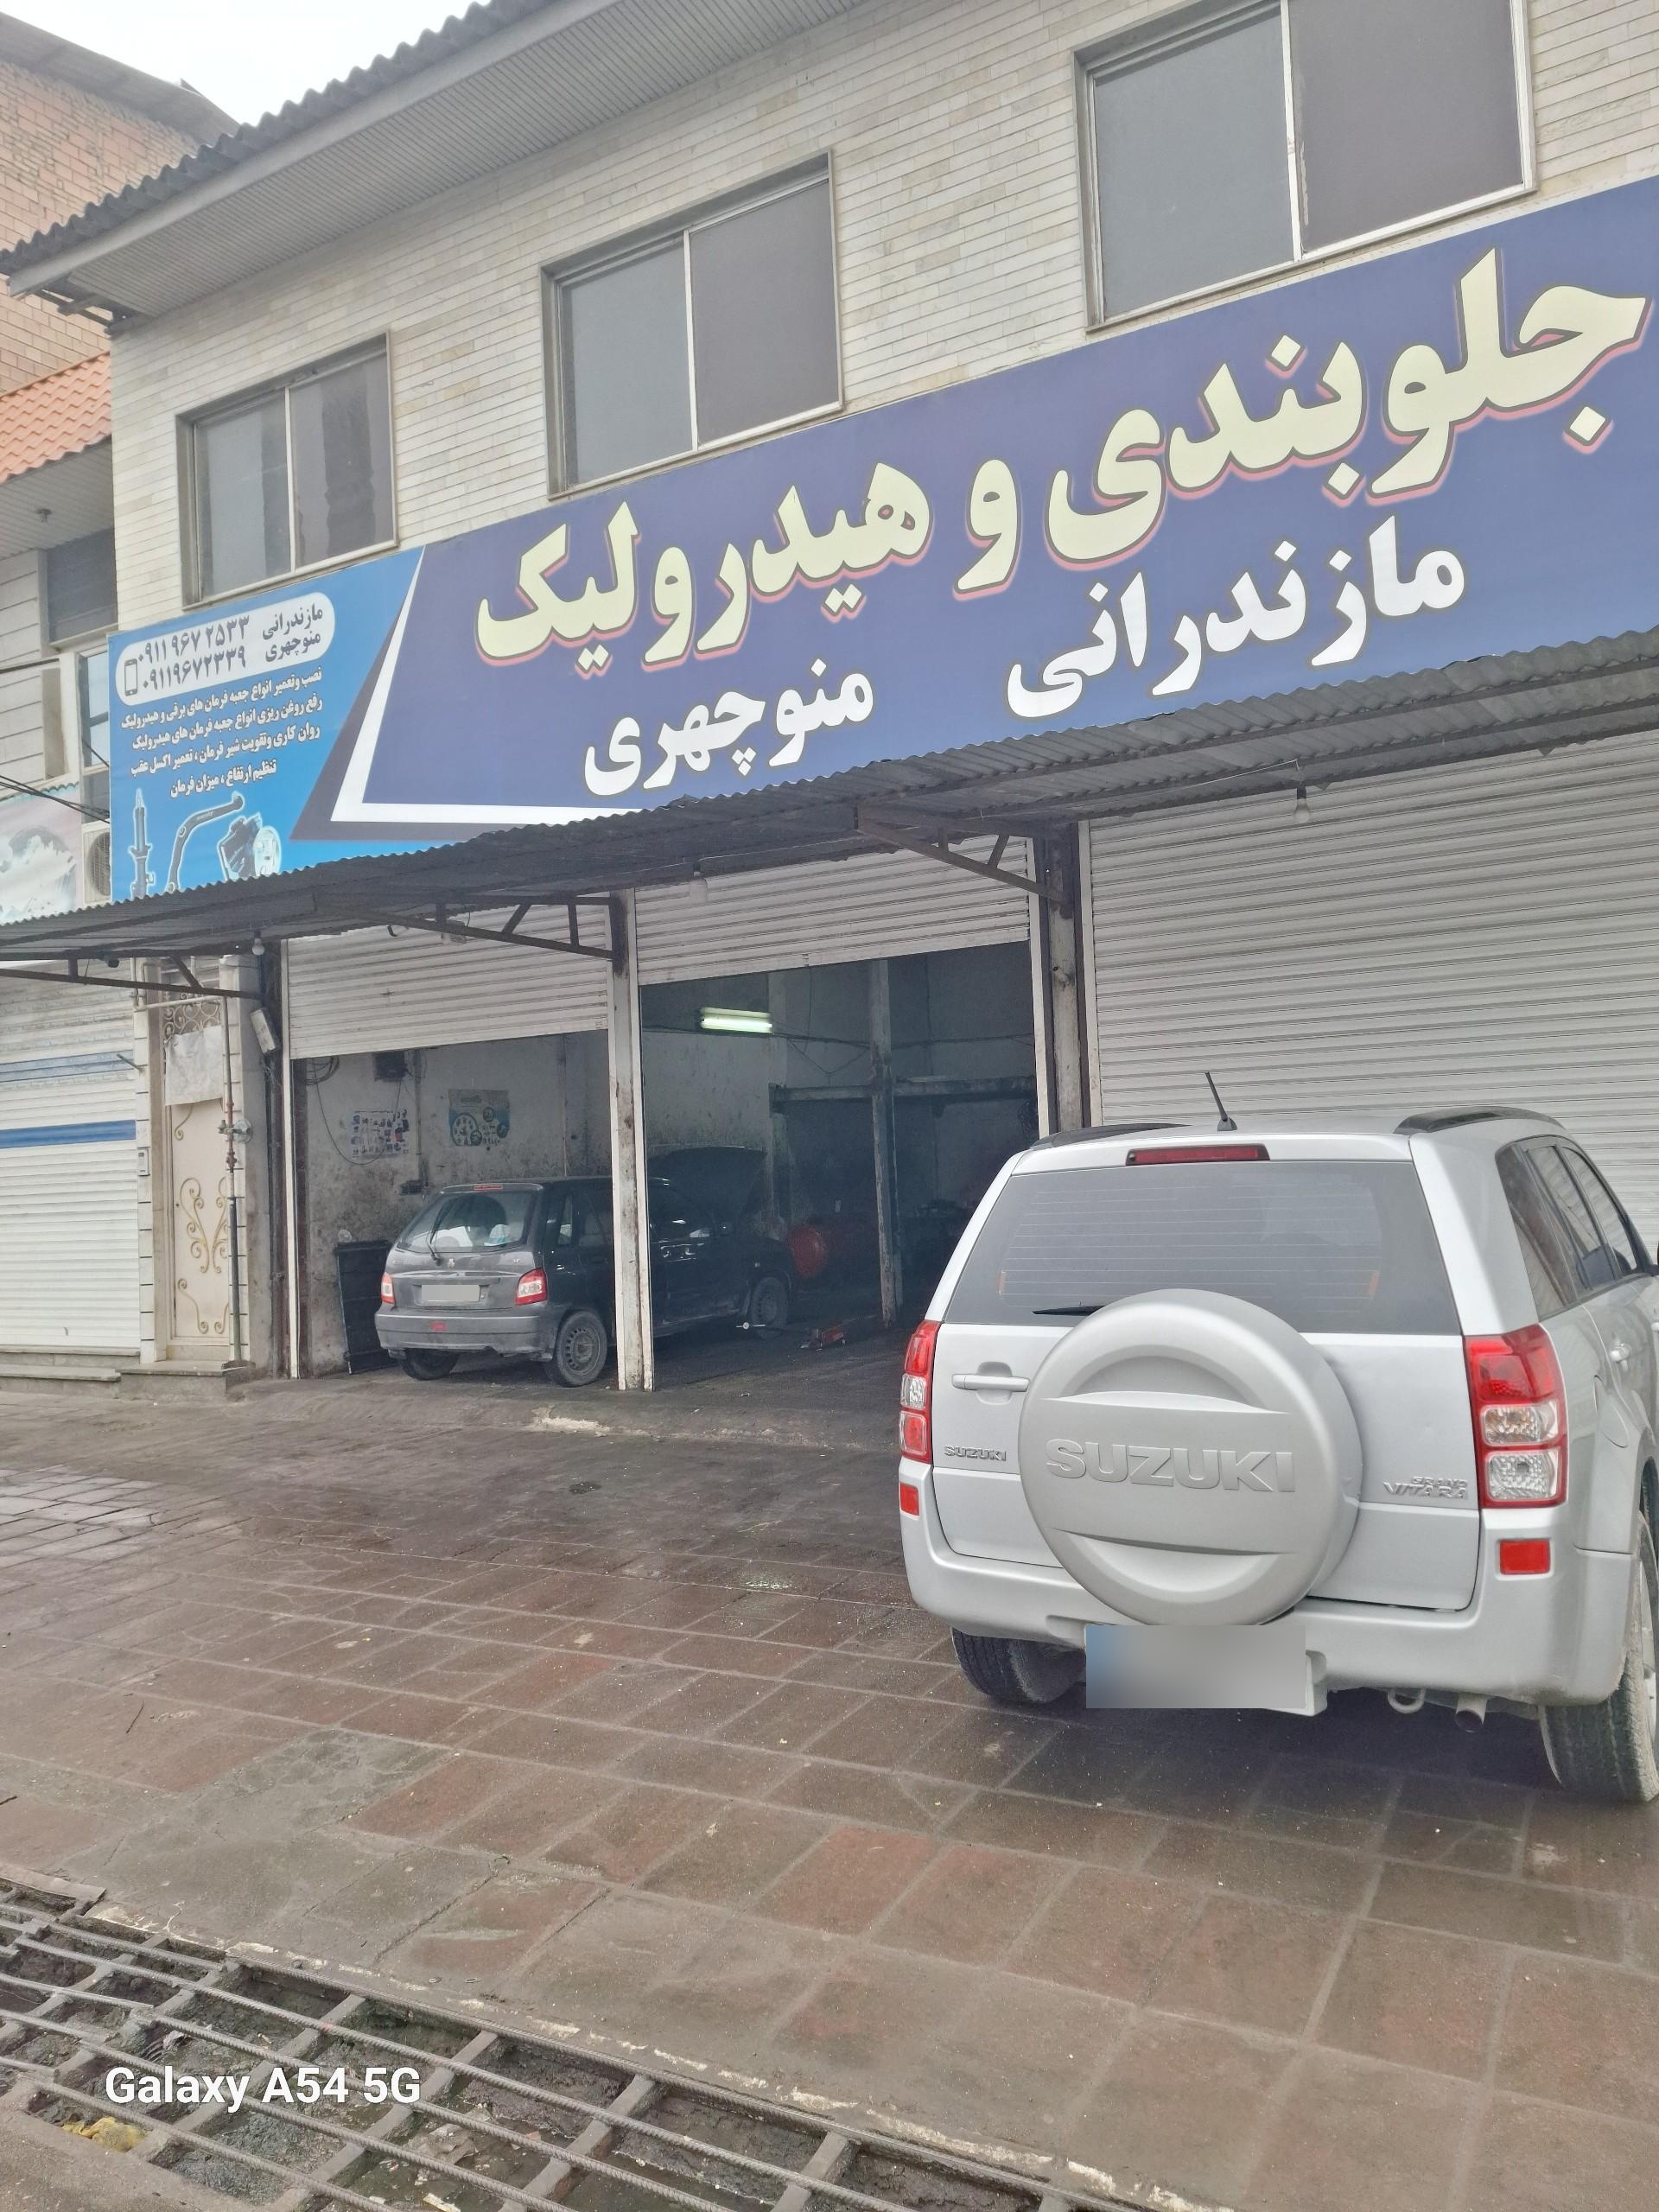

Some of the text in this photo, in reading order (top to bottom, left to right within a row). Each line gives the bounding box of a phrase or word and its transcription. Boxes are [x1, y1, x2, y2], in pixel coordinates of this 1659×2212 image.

[475, 247, 1648, 672] جلوبندی و هیدرولیک
[137, 603, 323, 664] مازندرانی ۰۹۱۱ ۹۶۷ ۲۵۳۳
[143, 629, 321, 690] منوچهری ۰۹۱۱۹۶۷۲۳۳۹
[584, 514, 1466, 796] مازندرانی منوچهری
[301, 666, 322, 688] نصب
[229, 689, 249, 704] جعبه
[251, 679, 272, 701] انواع
[166, 702, 186, 721] برقی
[187, 697, 203, 716] های
[204, 690, 228, 712] فرمان
[121, 711, 159, 729] هیدرولیک
[132, 692, 323, 751] رفع روغن ریزی انواع جعبه فرمان های هیدرولیک
[160, 711, 165, 723] و
[273, 725, 296, 747] کاری
[297, 721, 321, 741] روان
[225, 738, 240, 758] شیر
[130, 760, 149, 777] عقب
[149, 753, 171, 773] اکسل
[173, 749, 193, 770] تعمیر
[252, 759, 276, 781] تنظیم
[170, 776, 194, 798] فرمان
[195, 773, 219, 792] میزان
[944, 1445, 1007, 1462] SUZUKI
[1043, 1437, 1296, 1494] SUZUKI
[1382, 1481, 1467, 1499] VITARA
